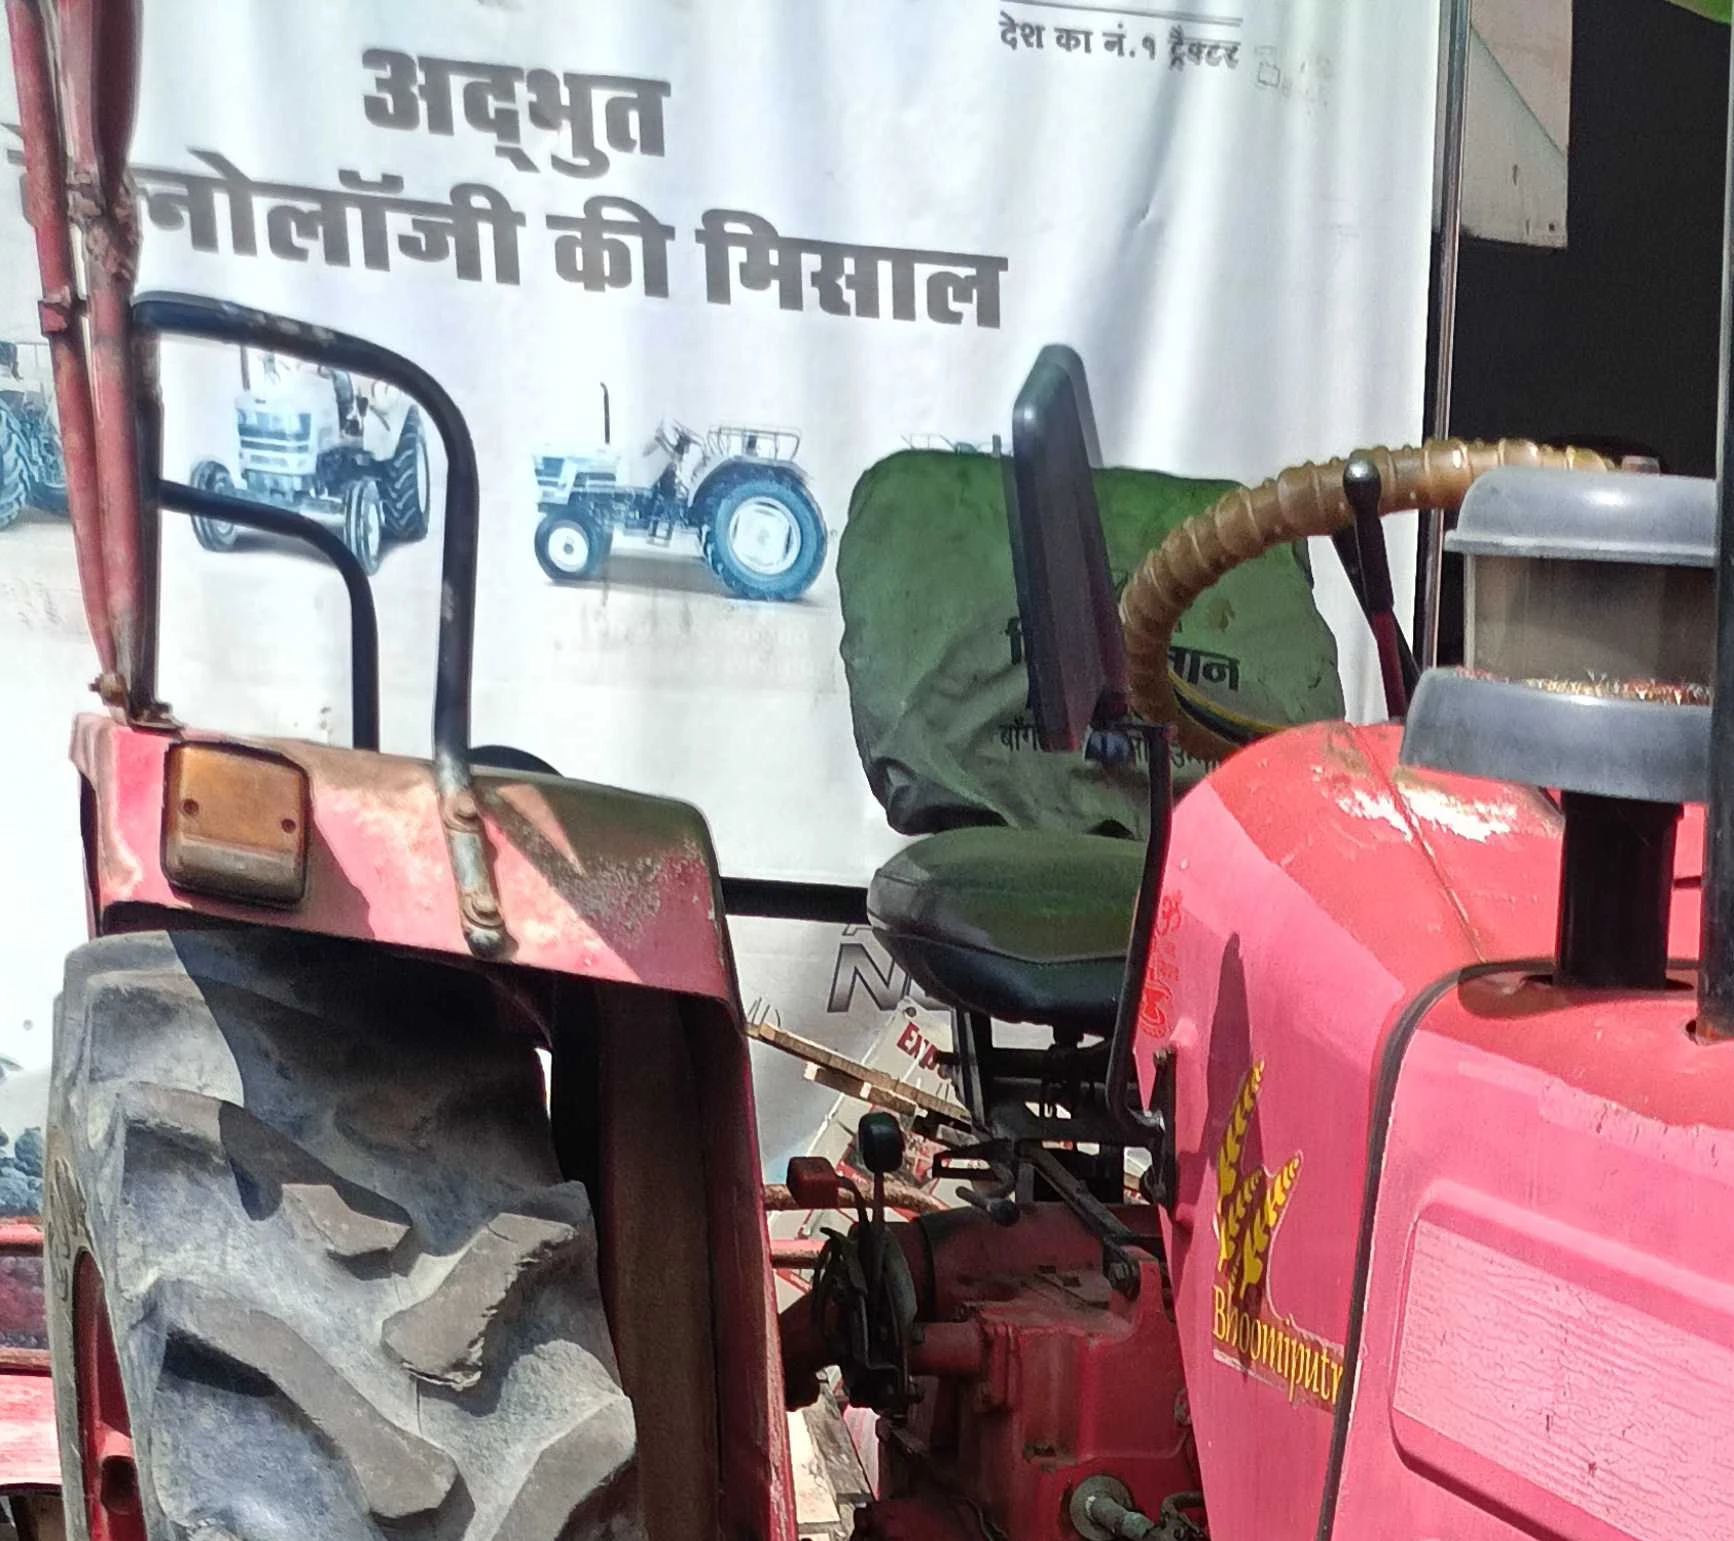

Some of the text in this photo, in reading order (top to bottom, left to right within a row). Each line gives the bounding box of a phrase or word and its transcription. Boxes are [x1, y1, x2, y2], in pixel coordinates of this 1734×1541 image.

[999, 10, 1046, 50] देश
[1054, 27, 1093, 54] का
[546, 195, 675, 299] की
[695, 208, 1008, 329] मिसाल
